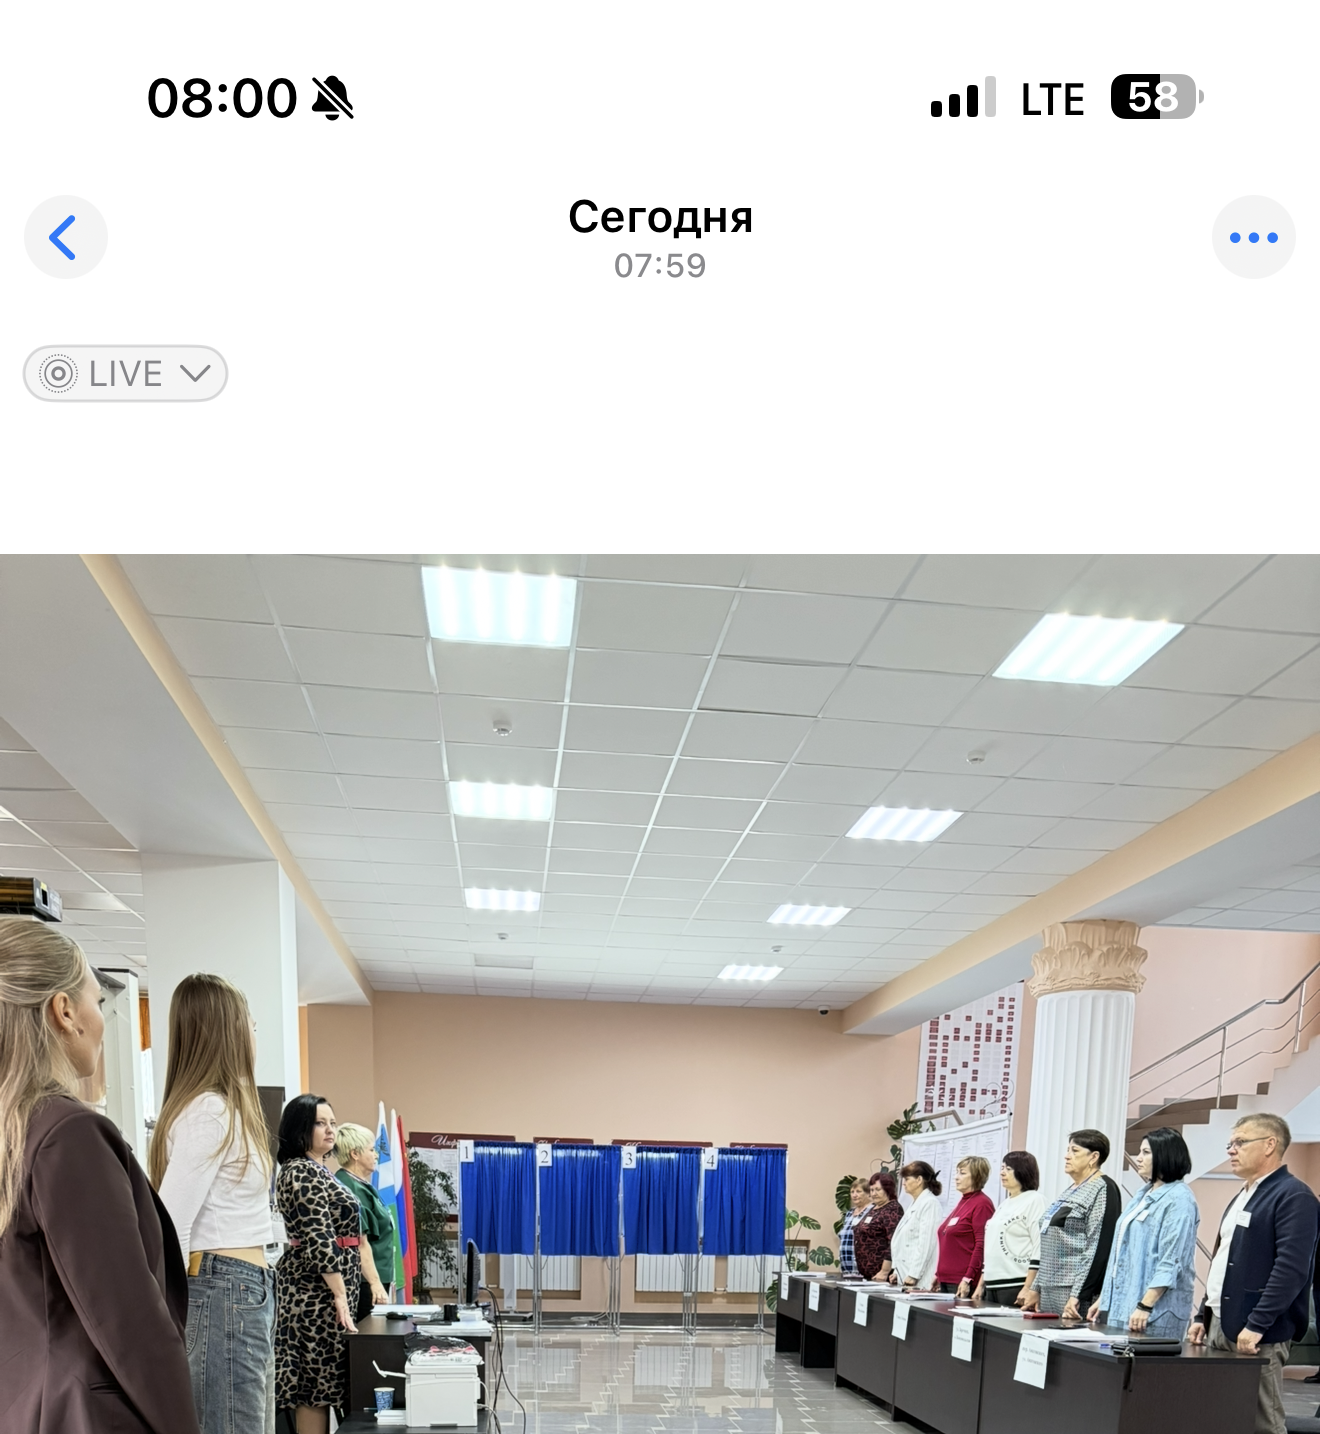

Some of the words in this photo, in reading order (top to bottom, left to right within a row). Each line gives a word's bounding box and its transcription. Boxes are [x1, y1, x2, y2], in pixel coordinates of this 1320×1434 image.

[464, 1145, 470, 1159] 1
[541, 1150, 549, 1164] 2
[625, 1152, 633, 1166] 3
[706, 1154, 715, 1167] 4
